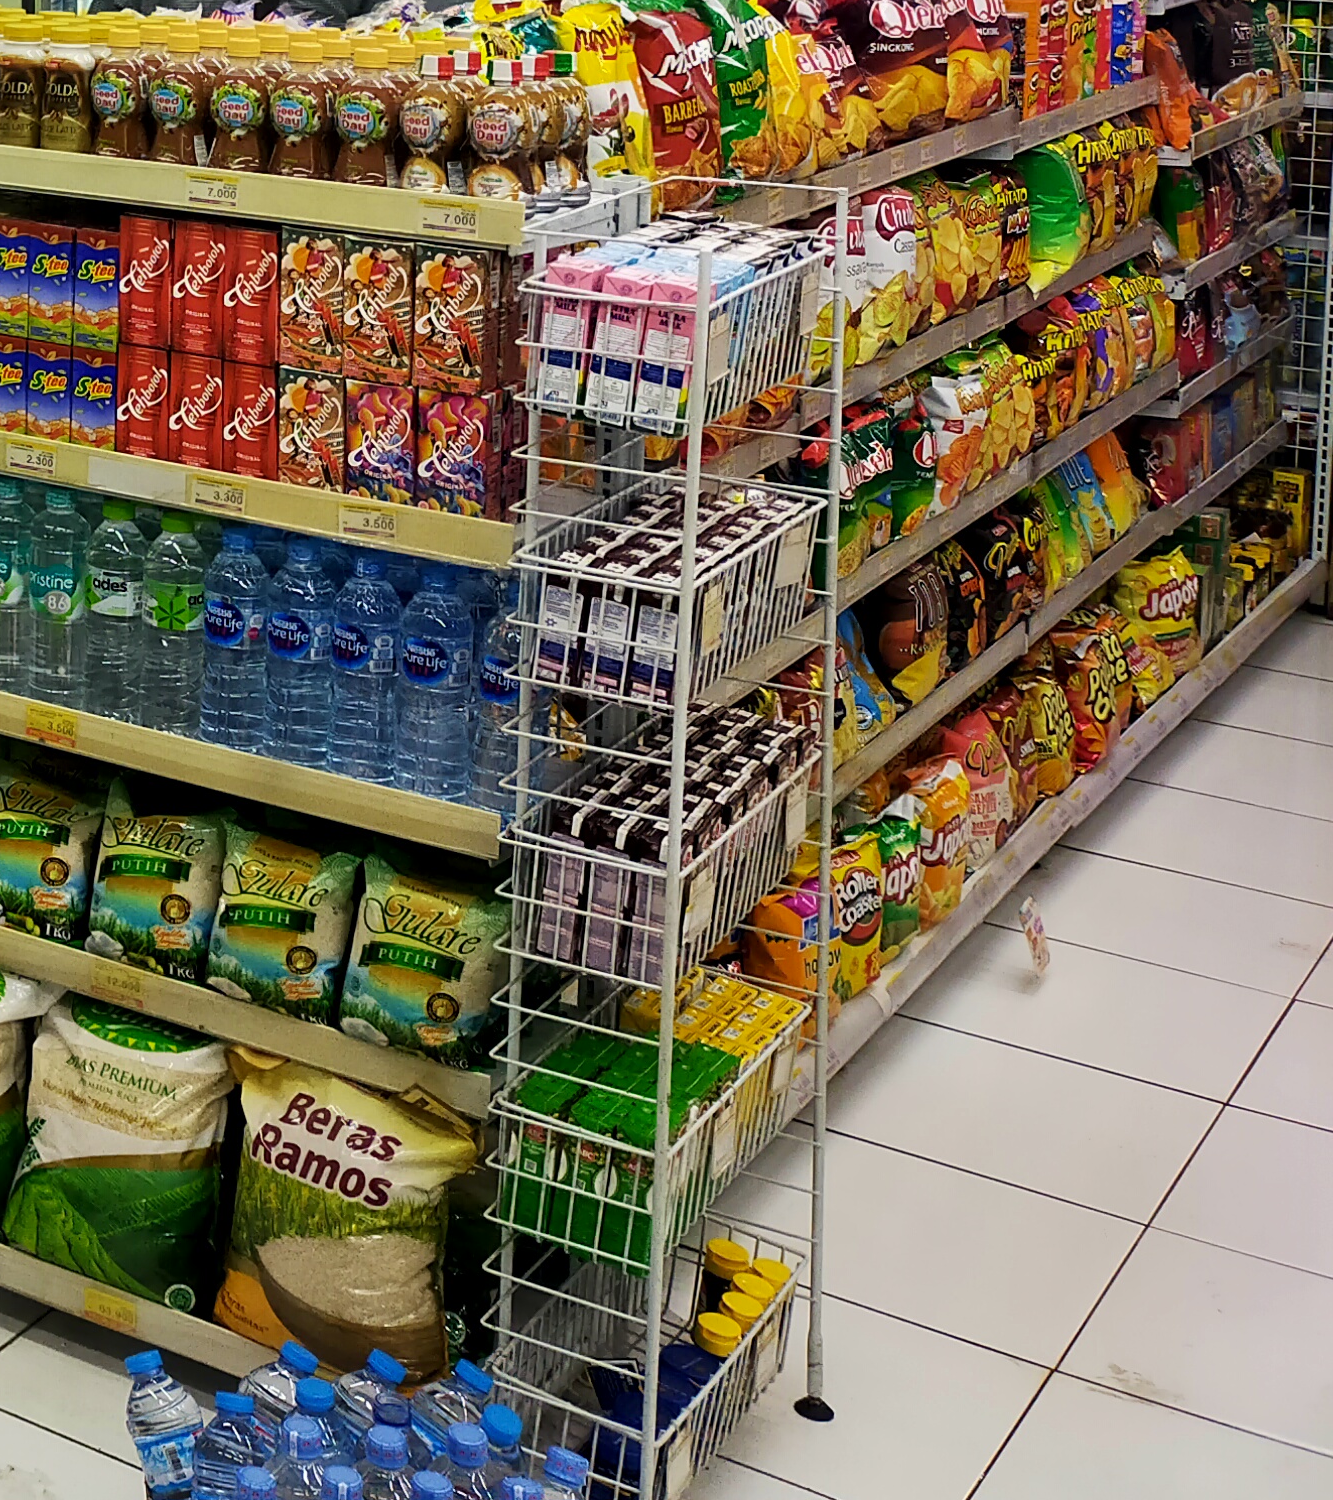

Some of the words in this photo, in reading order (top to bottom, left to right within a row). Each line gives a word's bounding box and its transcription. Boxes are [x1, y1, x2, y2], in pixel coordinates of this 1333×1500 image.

[93, 88, 117, 100] Good
[153, 93, 179, 105] Good
[96, 96, 115, 114] Day
[152, 102, 177, 116] Day
[219, 101, 249, 114] Good
[275, 105, 303, 120] Good
[222, 110, 247, 123] Day
[276, 114, 301, 129] Day
[340, 108, 371, 123] Good
[403, 115, 431, 126] Good
[339, 119, 366, 134] Day
[403, 125, 430, 136] Day
[473, 119, 508, 132] Good
[476, 130, 508, 144] Day
[207, 187, 237, 200] 7.000
[443, 213, 476, 227] 7.000
[33, 254, 68, 278] S-tee
[78, 260, 115, 283] S-tee
[119, 237, 169, 293] Tehbotol
[173, 242, 226, 298] Tehbotol
[224, 252, 278, 307] Tehbotol
[281, 256, 343, 315] Tehbotol
[344, 266, 407, 326] Tehbotol
[415, 273, 482, 334] Tehbotol
[30, 370, 67, 394] S-tee
[75, 378, 112, 401] S-tee
[117, 365, 167, 421] Tehbotol
[169, 374, 223, 431] Tehbotol
[223, 387, 276, 441] Tehbotol
[280, 397, 342, 454] Tehbotol
[347, 408, 411, 468] Tehbotol
[417, 419, 484, 478] Tehbotol
[26, 455, 54, 468] 2.300
[213, 491, 243, 505] 3.300
[362, 518, 395, 531] 3.500
[93, 576, 128, 593] ades
[224, 618, 243, 631] Life
[289, 629, 310, 643] Life
[347, 641, 368, 655] Life
[426, 656, 448, 670] Life
[111, 859, 168, 875] PUTIH
[221, 859, 329, 908] Gulare
[835, 872, 879, 909] Roller
[233, 910, 291, 925] PUTIH
[840, 895, 882, 933] Coaster
[364, 893, 481, 955] Gulare
[378, 947, 438, 971] PUTIH
[99, 1061, 177, 1101] PREMIUM
[279, 1092, 403, 1162] Beras
[251, 1123, 394, 1207] Ramos
